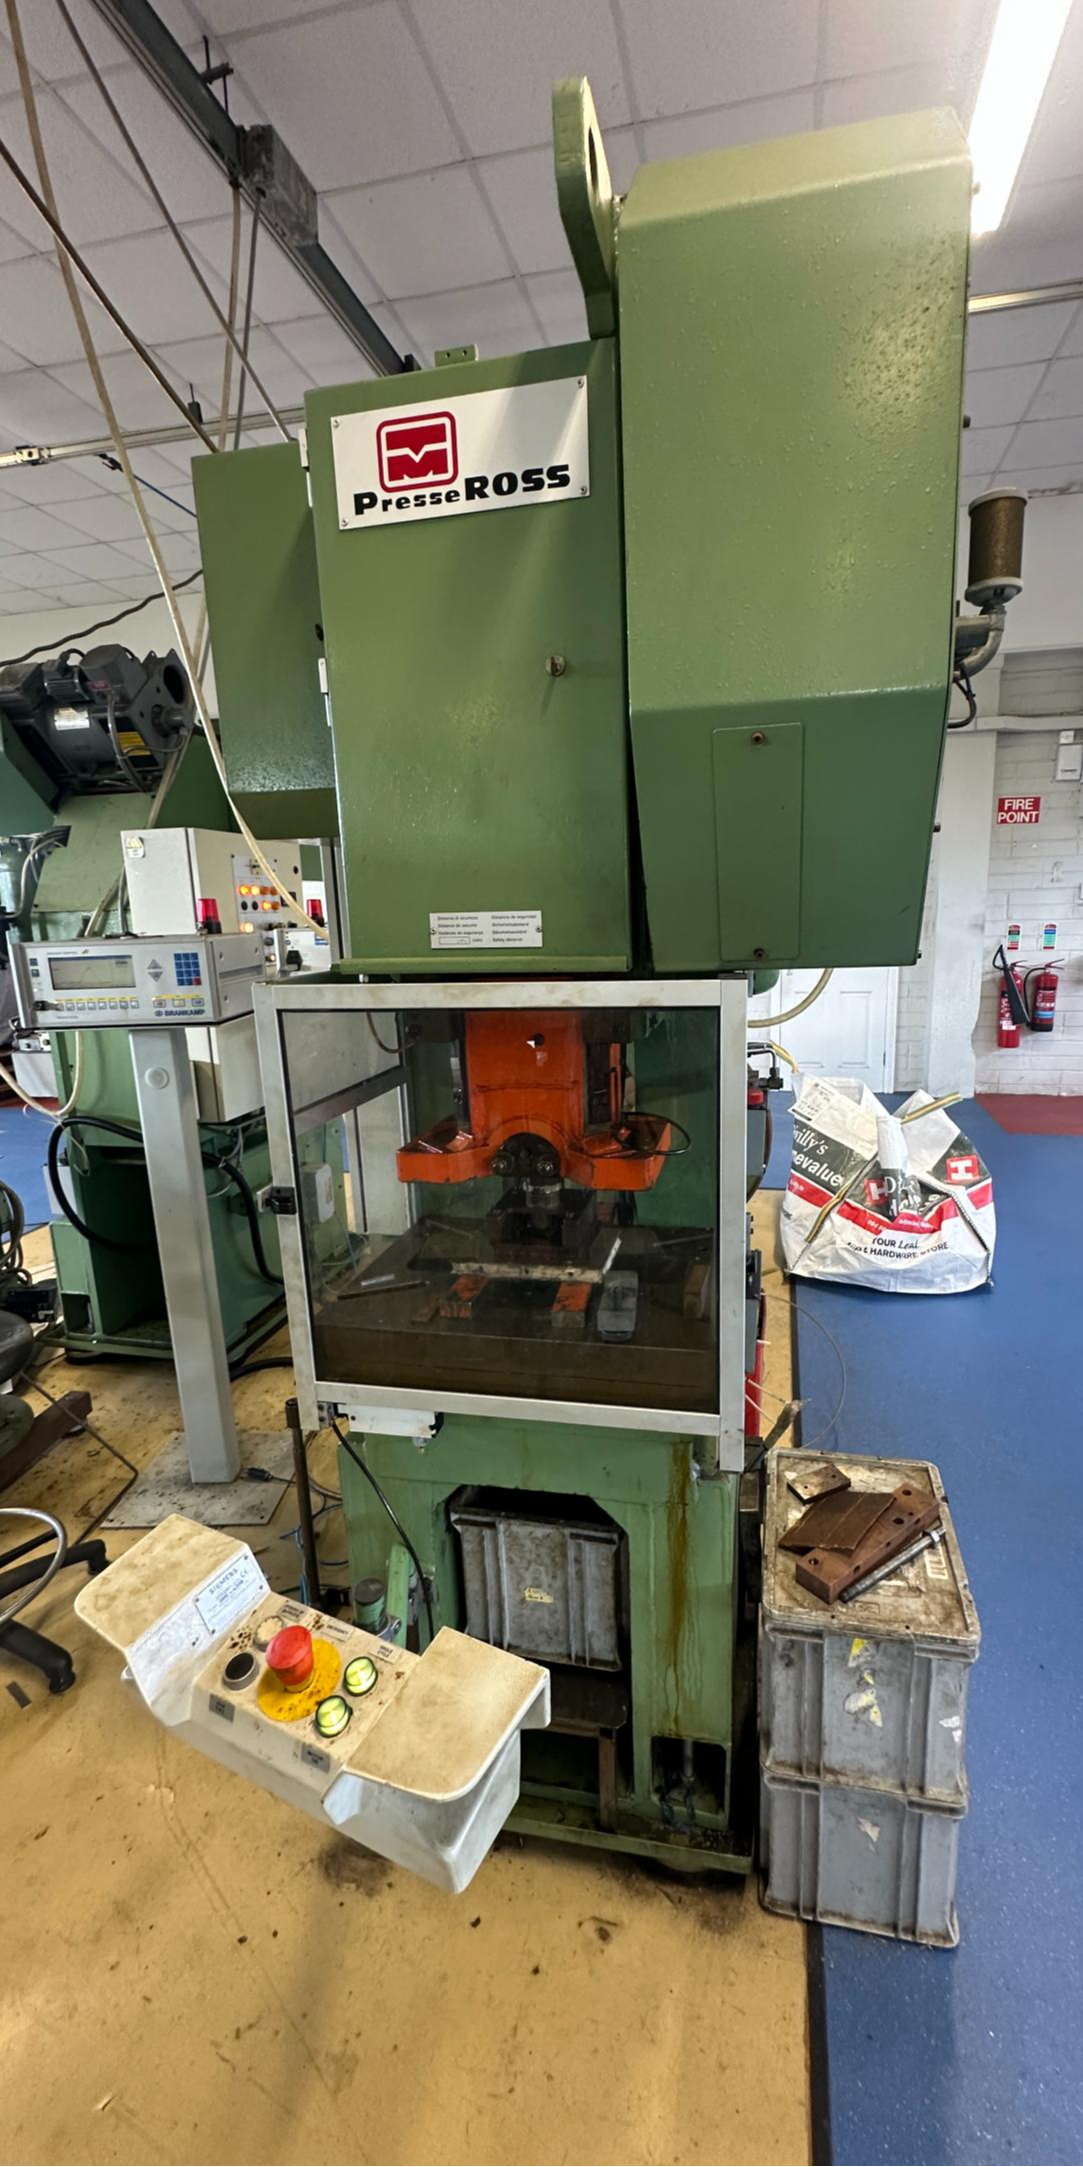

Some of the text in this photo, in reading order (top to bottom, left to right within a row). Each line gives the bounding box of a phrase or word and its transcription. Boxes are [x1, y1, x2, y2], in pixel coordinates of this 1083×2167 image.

[1003, 798, 1034, 810] FIRE
[997, 811, 1039, 823] POINT
[164, 1008, 206, 1017] BRANKAMP
[208, 1567, 238, 1595] SIEMENS
